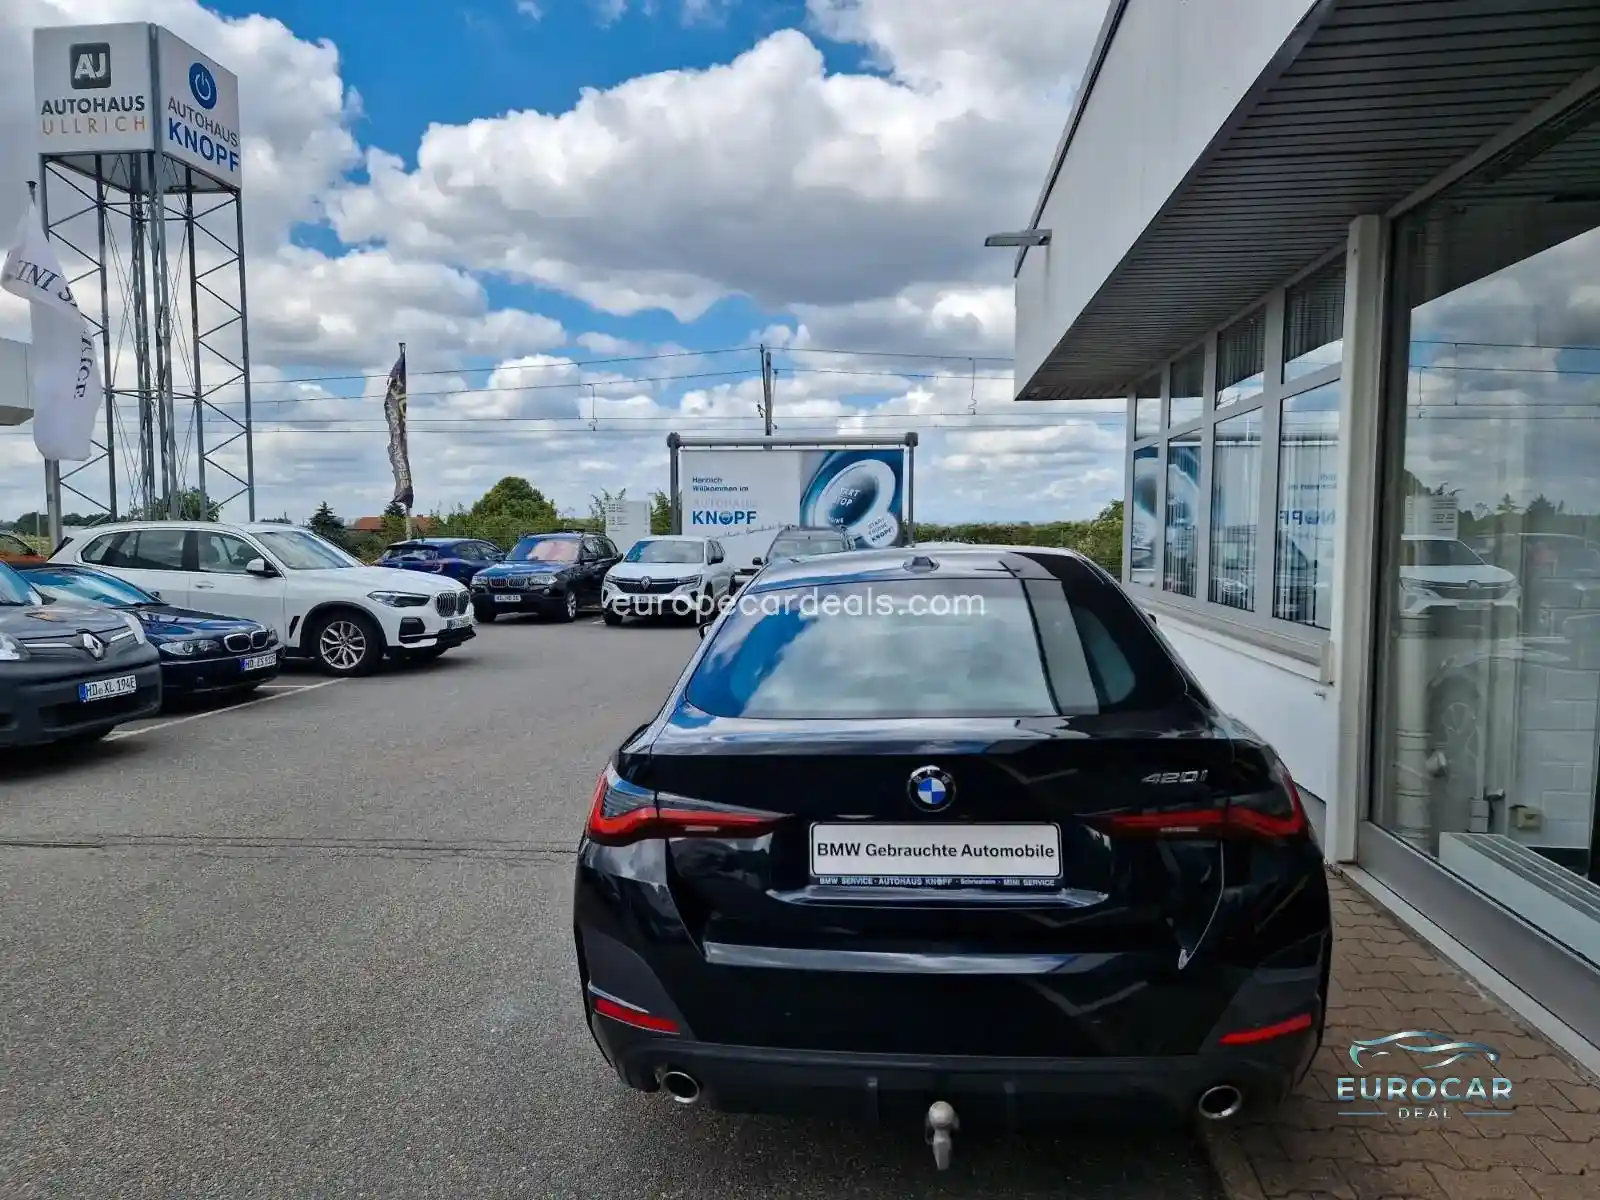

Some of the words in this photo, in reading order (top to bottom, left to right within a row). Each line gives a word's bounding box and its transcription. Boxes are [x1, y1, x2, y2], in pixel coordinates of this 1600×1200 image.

[41, 95, 146, 116] AUTOHAUS
[42, 116, 146, 136] ULLRICH
[168, 97, 239, 148] AUTOHAUS
[168, 118, 240, 173] KNOPF
[15, 260, 60, 292] INI
[692, 510, 757, 525] KNOPF
[86, 684, 99, 700] HD
[103, 681, 115, 695] XL
[117, 677, 136, 692] 194E
[1141, 769, 1208, 784] 420i
[817, 843, 861, 857] BMW
[865, 843, 957, 858] Gebrauchte
[961, 843, 1055, 859] Automobile
[819, 877, 838, 885] BMW
[841, 877, 874, 885] SERVICE
[878, 877, 923, 886] AUTOHAUS
[925, 878, 953, 886] KNOPF
[1023, 879, 1055, 887] SERVICE
